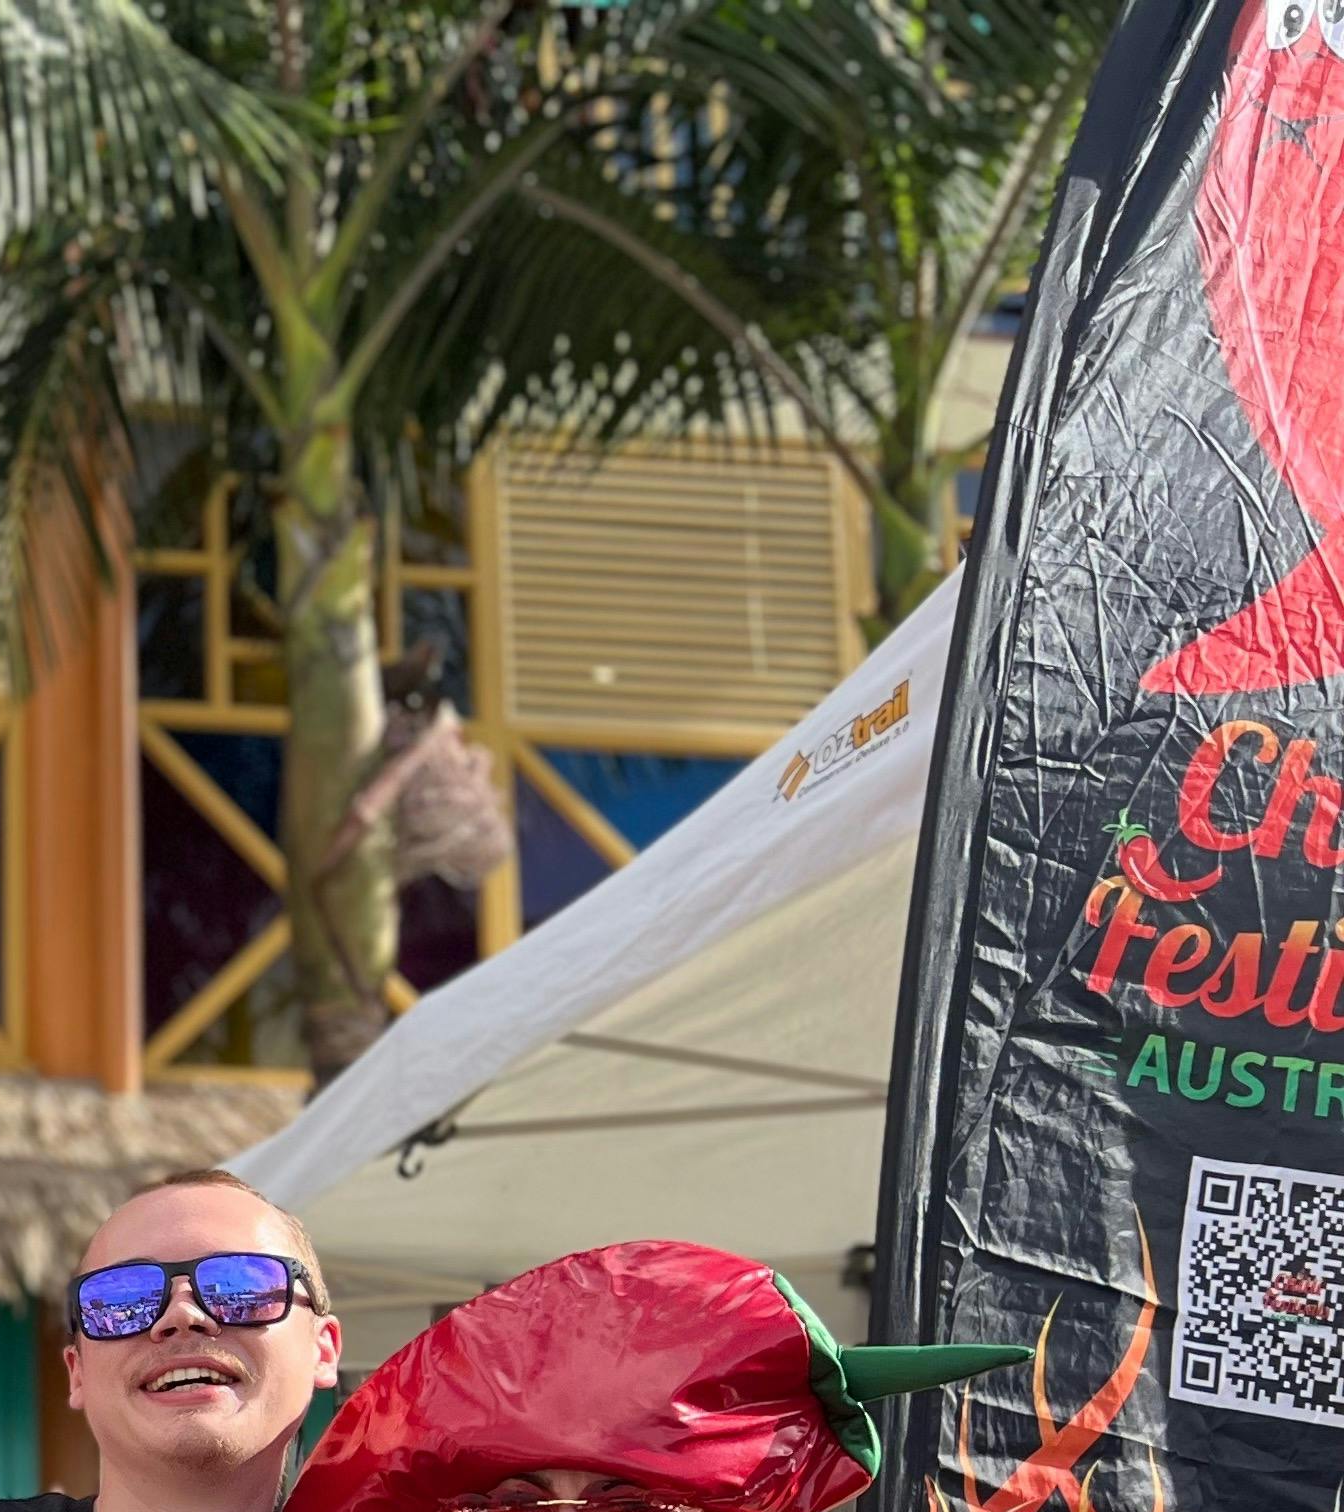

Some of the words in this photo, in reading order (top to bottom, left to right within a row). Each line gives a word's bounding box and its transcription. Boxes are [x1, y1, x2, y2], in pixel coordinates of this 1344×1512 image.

[1178, 719, 1344, 868] Ch
[1085, 875, 1344, 1033] Festi
[1126, 1033, 1344, 1118] AUSTR
